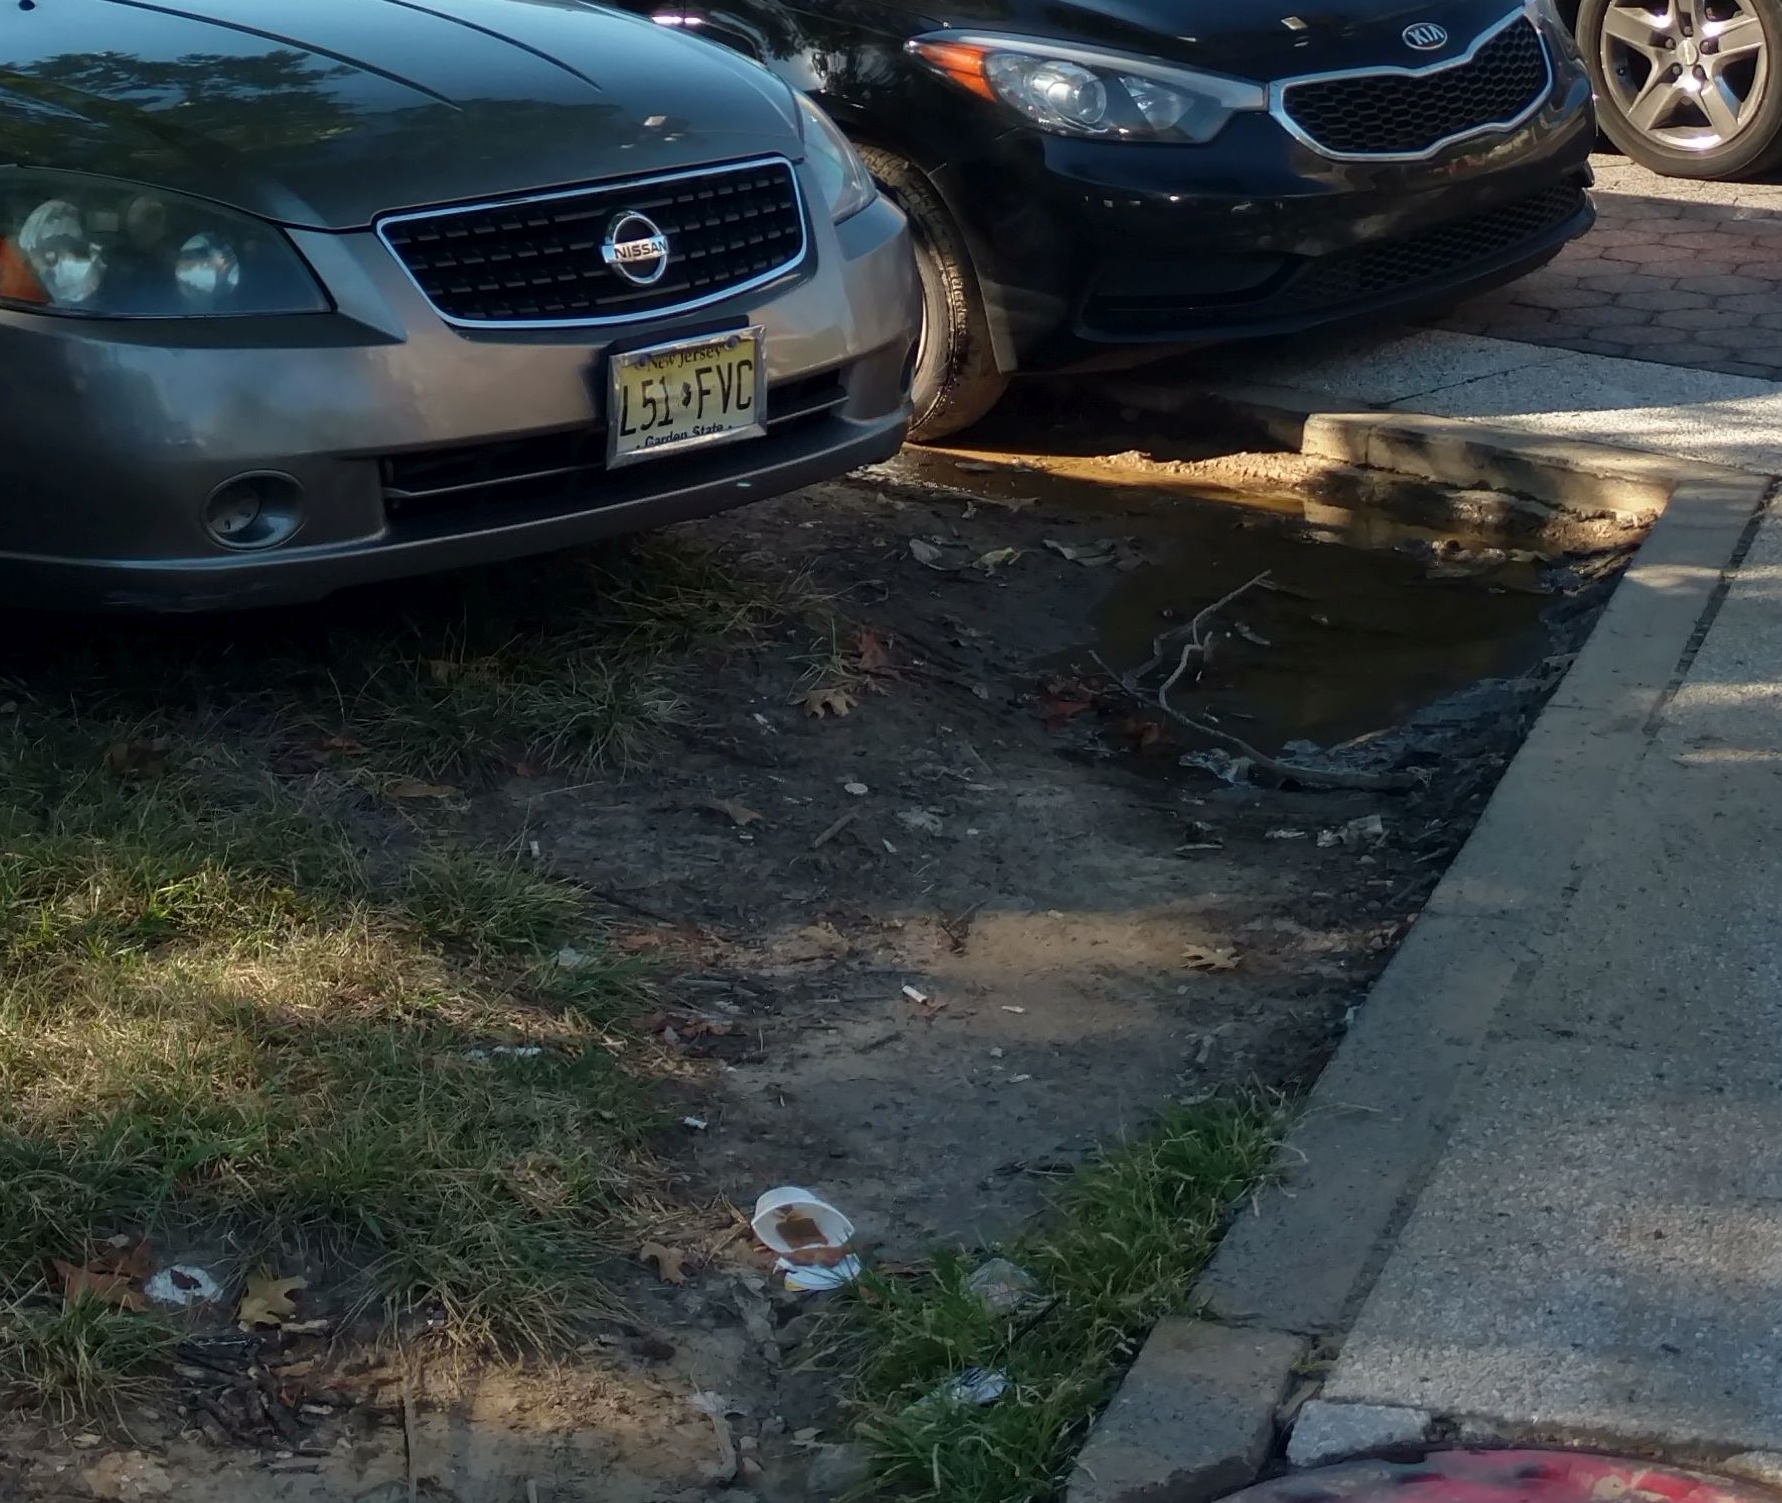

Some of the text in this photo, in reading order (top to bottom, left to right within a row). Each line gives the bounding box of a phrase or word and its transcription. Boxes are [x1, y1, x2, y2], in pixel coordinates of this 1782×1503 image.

[1407, 25, 1445, 45] KIA
[614, 239, 668, 260] NISSAN
[647, 344, 722, 372] New Jersey
[619, 358, 754, 437] L51 FVC
[644, 423, 724, 448] Garden State
